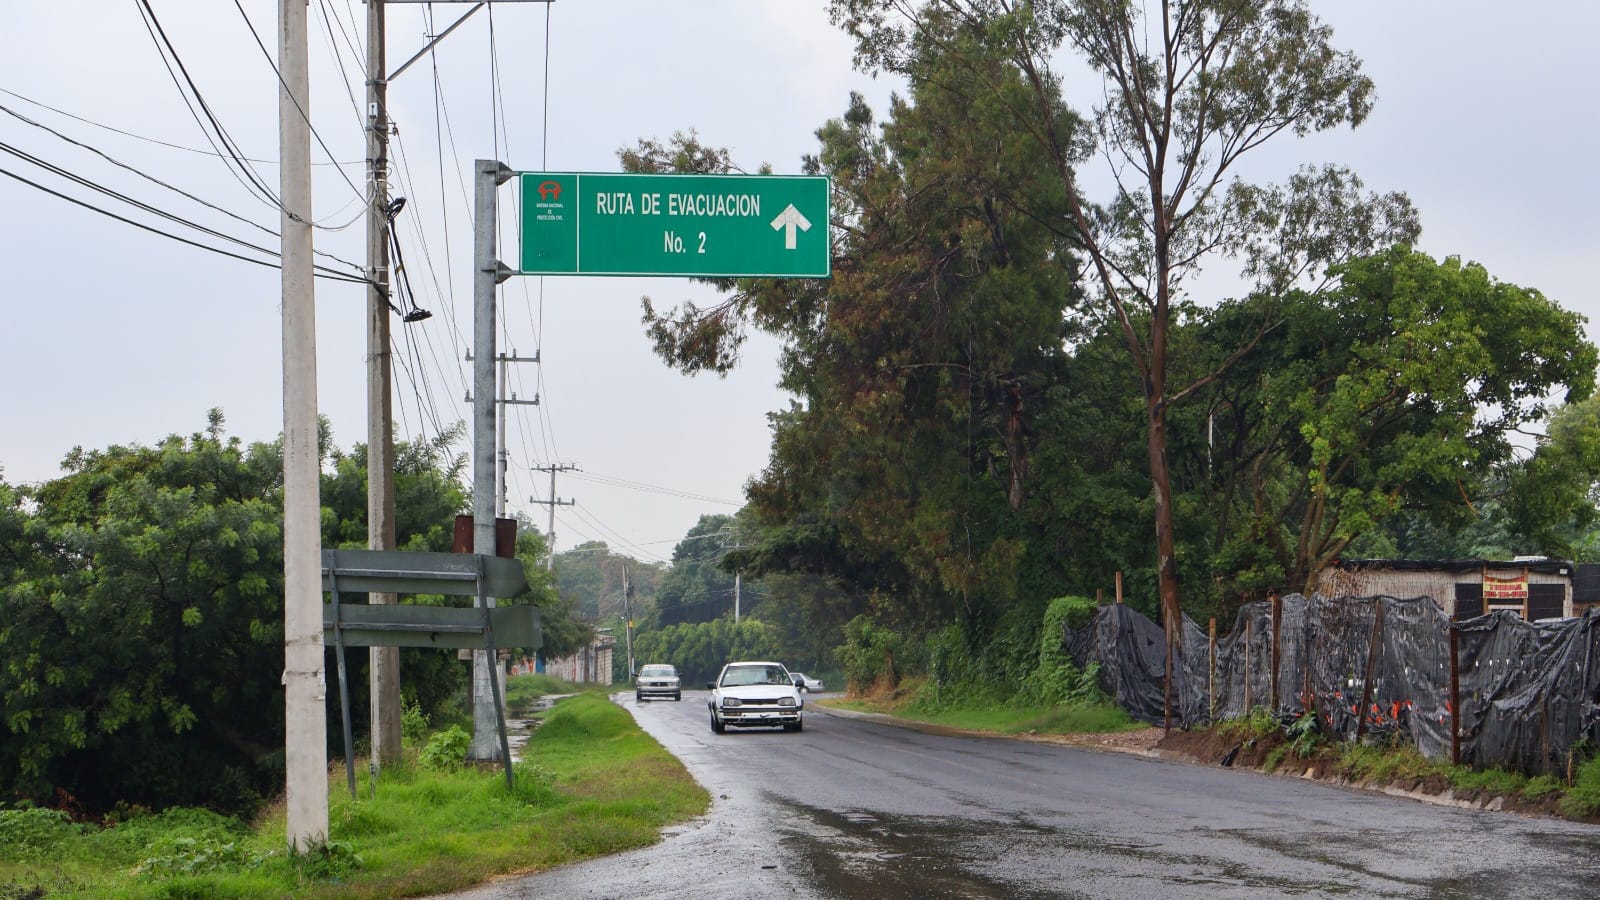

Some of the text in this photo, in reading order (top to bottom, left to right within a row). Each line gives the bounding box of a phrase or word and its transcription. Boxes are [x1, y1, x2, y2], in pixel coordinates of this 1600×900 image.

[597, 192, 760, 217] RUTA DE EVACUACION
[664, 231, 706, 253] No. 2
